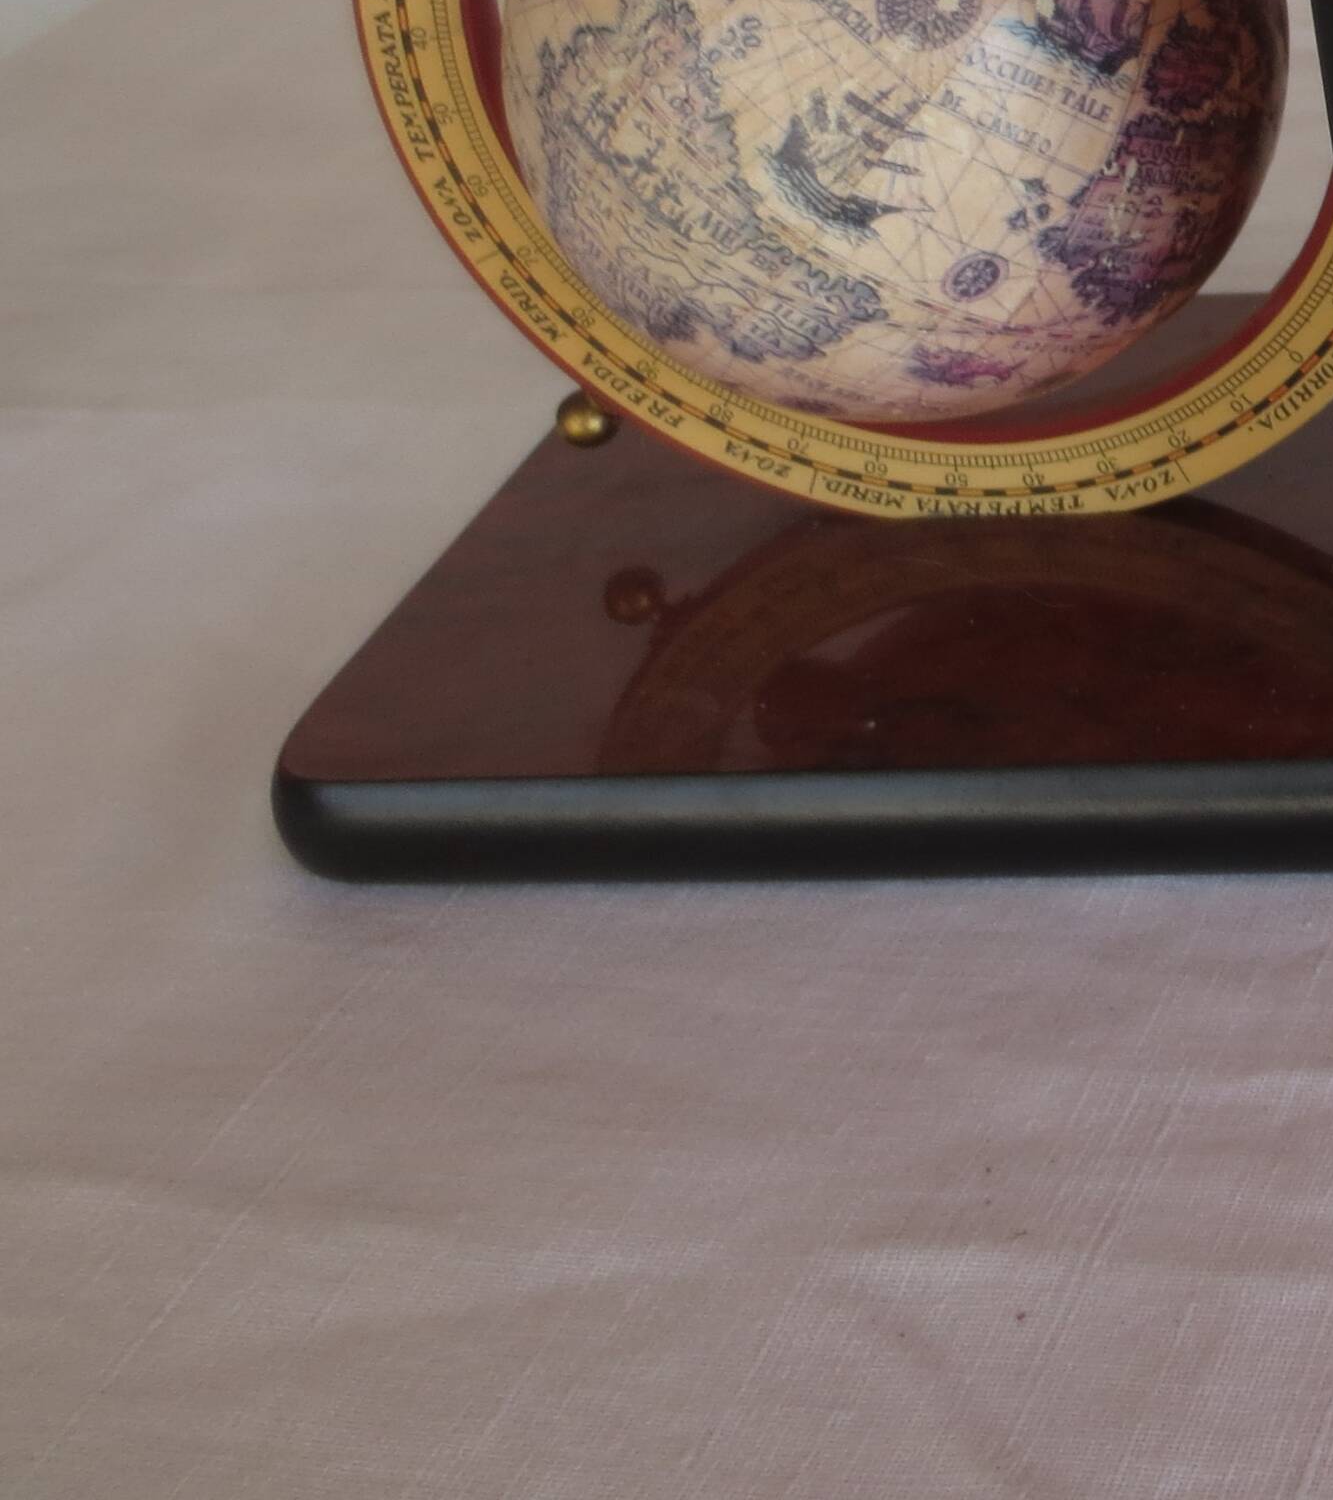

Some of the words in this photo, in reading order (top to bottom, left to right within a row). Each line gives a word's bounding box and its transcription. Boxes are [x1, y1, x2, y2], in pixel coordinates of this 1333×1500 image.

[411, 25, 428, 50] 40
[374, 11, 436, 163] TEMPERATA
[581, 351, 687, 429] FREDDA
